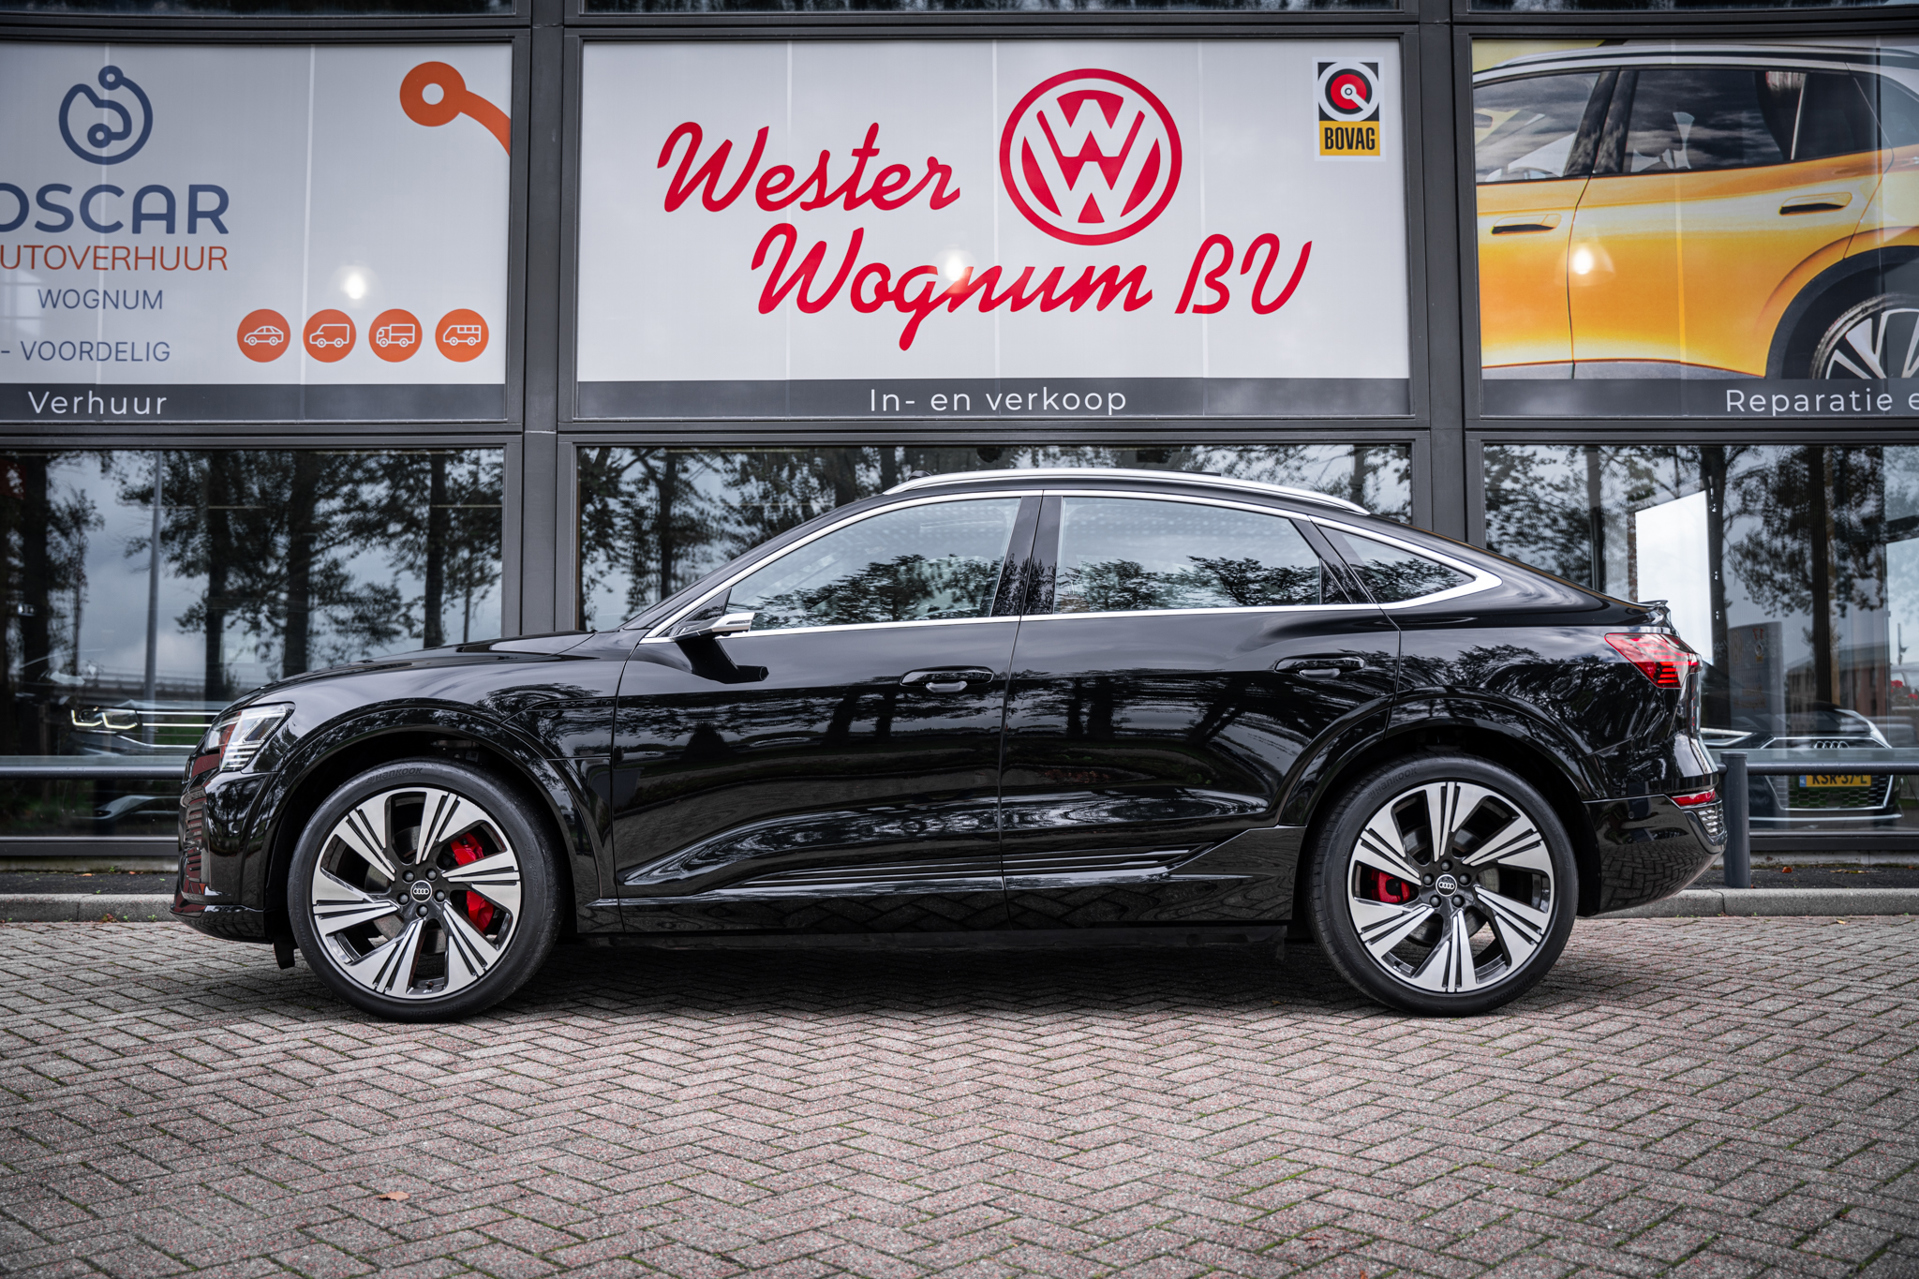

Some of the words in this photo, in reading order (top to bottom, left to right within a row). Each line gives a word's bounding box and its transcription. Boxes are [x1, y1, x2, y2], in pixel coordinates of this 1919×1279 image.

[1324, 127, 1375, 150] BOVAG
[657, 121, 960, 213] Wester
[0, 182, 229, 234] OSCAR
[38, 289, 163, 310] WOGNUM
[751, 222, 1153, 351] Wognum
[1174, 232, 1313, 315] BV
[20, 341, 171, 362] VOORDELIG
[28, 390, 167, 415] Verhuur
[871, 389, 915, 411] In-
[930, 393, 971, 411] en
[986, 387, 1126, 416] verkoop
[1726, 388, 1893, 417] Reparatie
